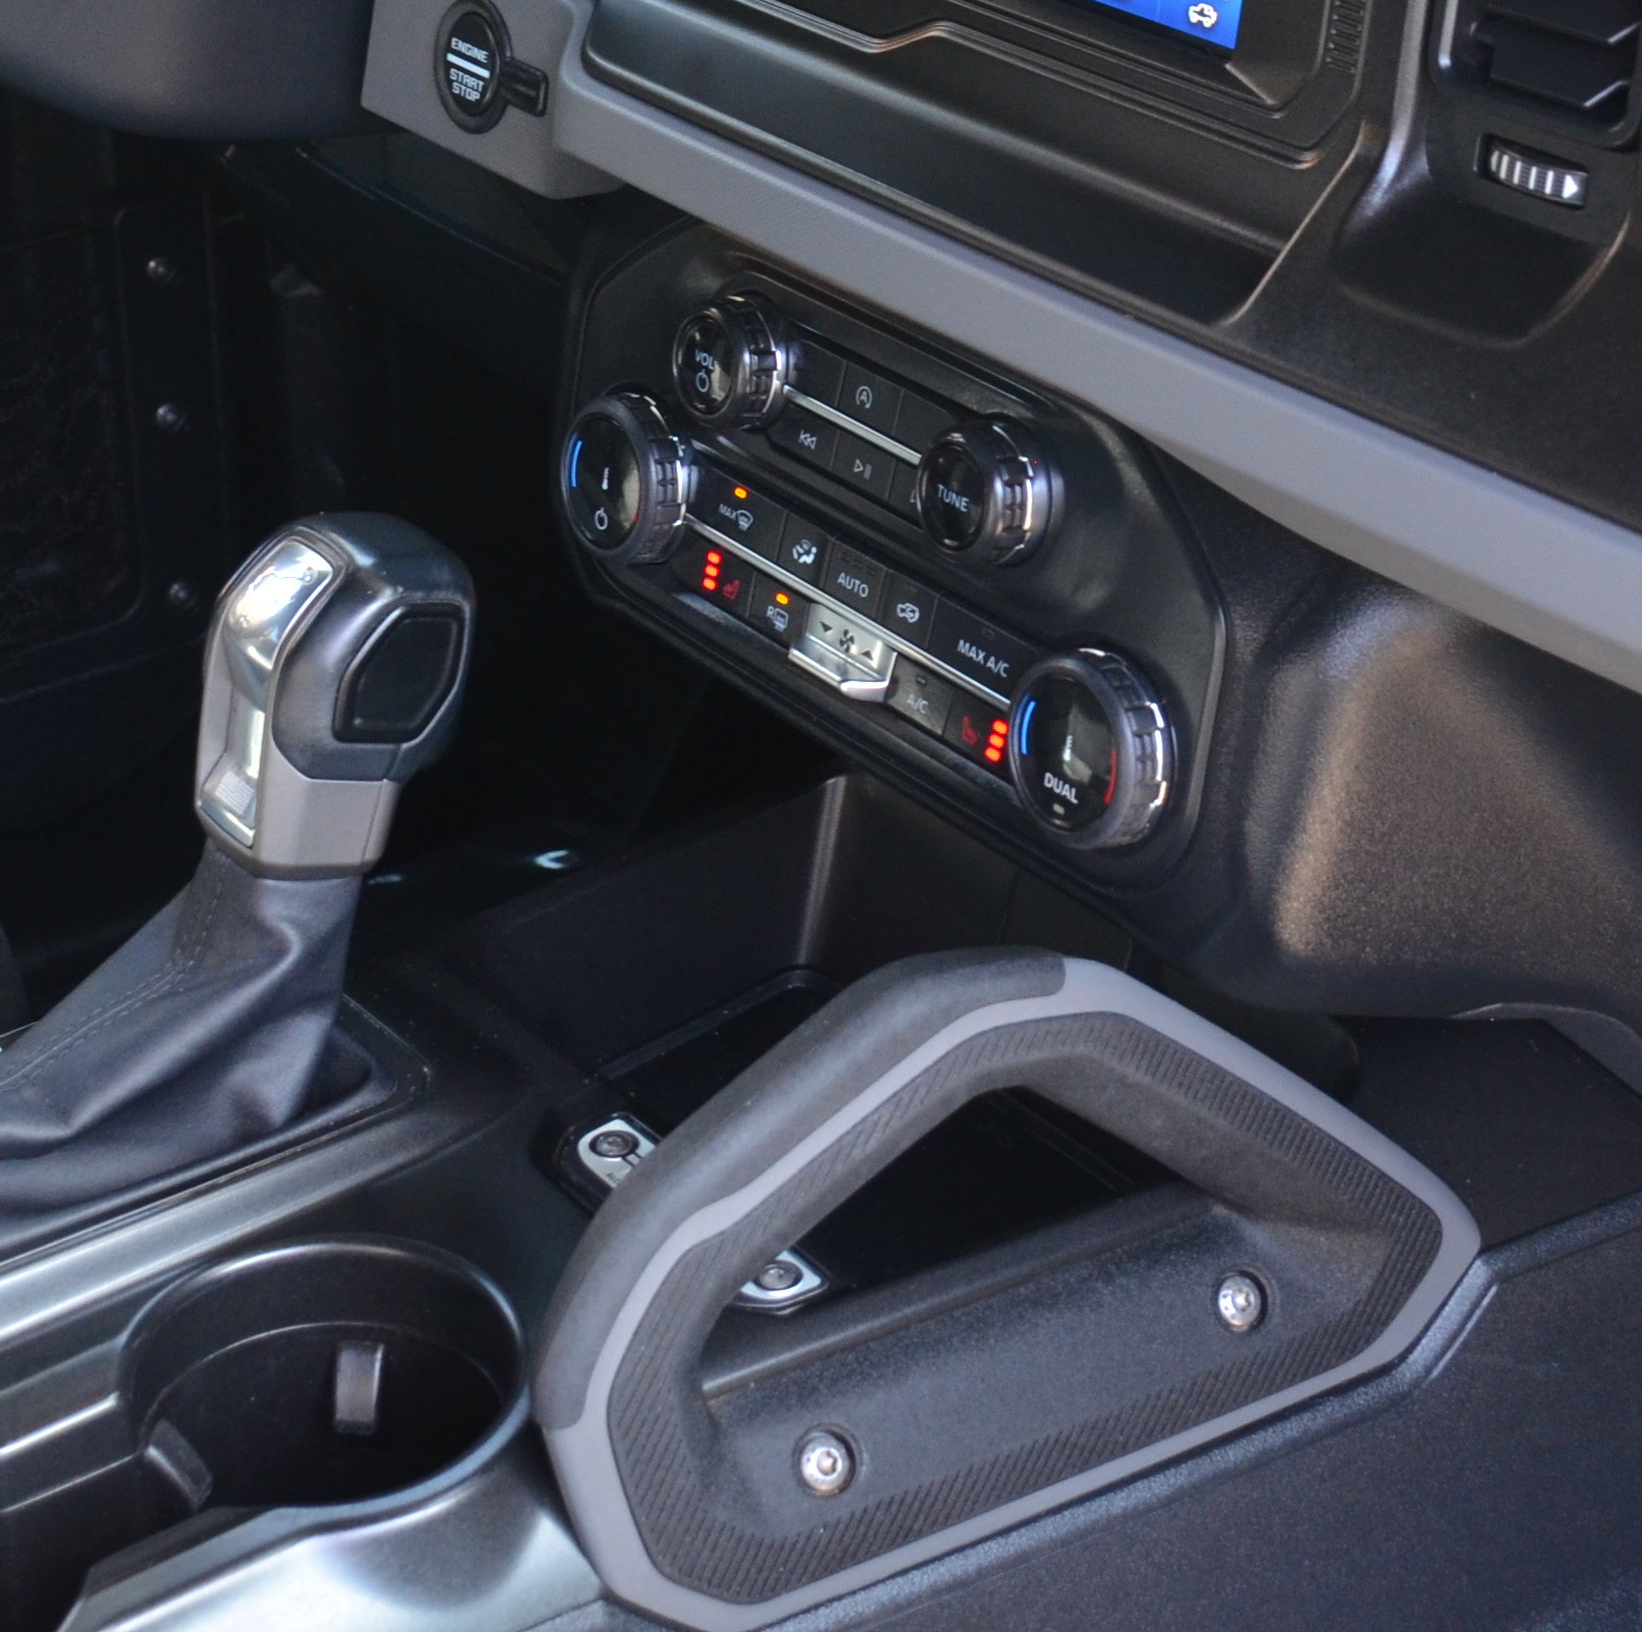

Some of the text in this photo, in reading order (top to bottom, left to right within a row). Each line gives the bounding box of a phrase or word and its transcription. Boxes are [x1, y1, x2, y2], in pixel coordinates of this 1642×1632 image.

[451, 37, 489, 63] ENGINE
[450, 68, 485, 92] START
[452, 82, 480, 102] STOP
[694, 348, 716, 370] VOL
[719, 503, 737, 520] MAX
[936, 485, 970, 513] TUNE
[837, 572, 869, 598] AUTO
[957, 640, 1009, 678] MAX A/C
[906, 693, 927, 714] A/C
[1043, 772, 1078, 804] DUAL
